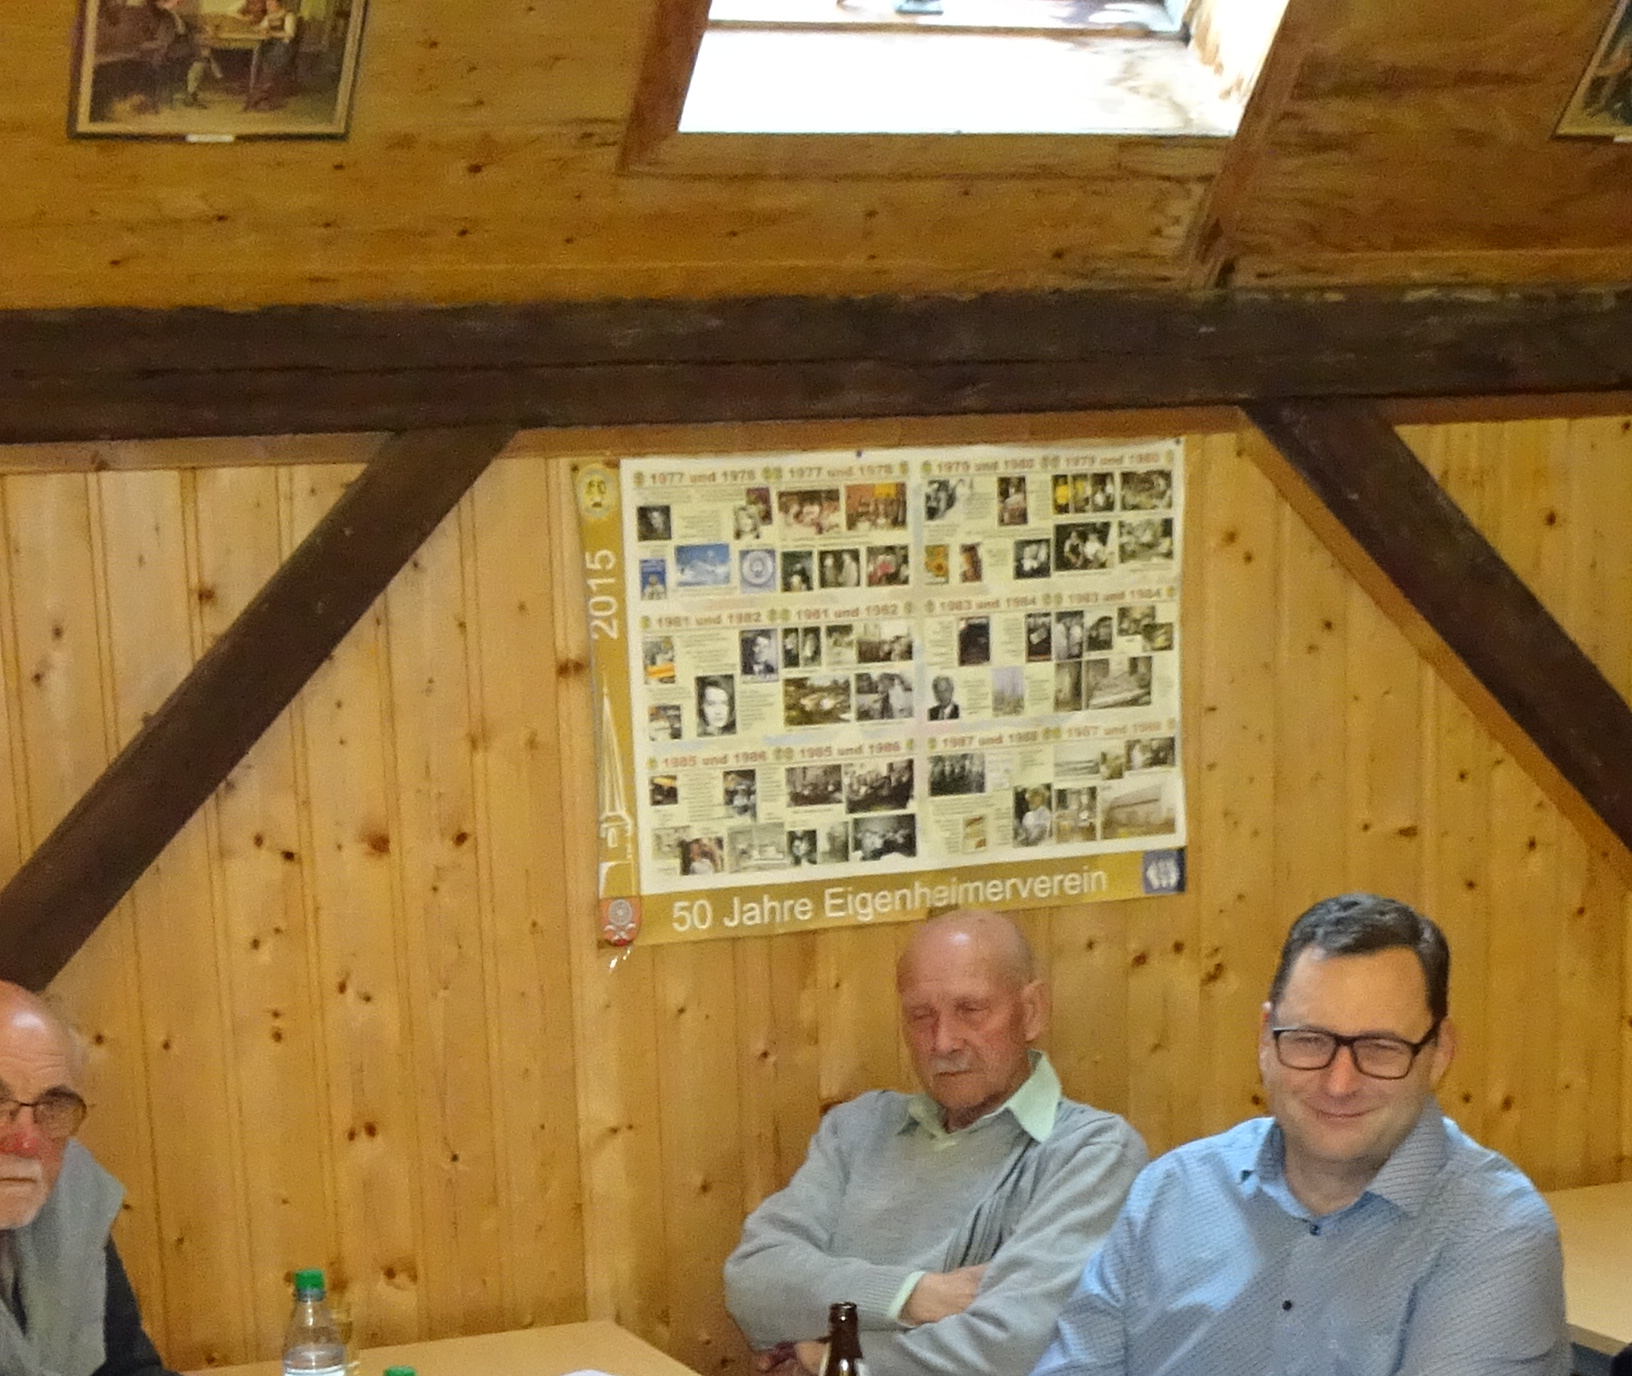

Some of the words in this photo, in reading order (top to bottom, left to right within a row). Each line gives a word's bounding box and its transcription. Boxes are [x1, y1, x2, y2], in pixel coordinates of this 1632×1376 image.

[585, 549, 619, 640] 2015
[672, 900, 713, 933] 50
[723, 891, 812, 928] Jahre
[824, 867, 1108, 922] Eigenheimerverein
